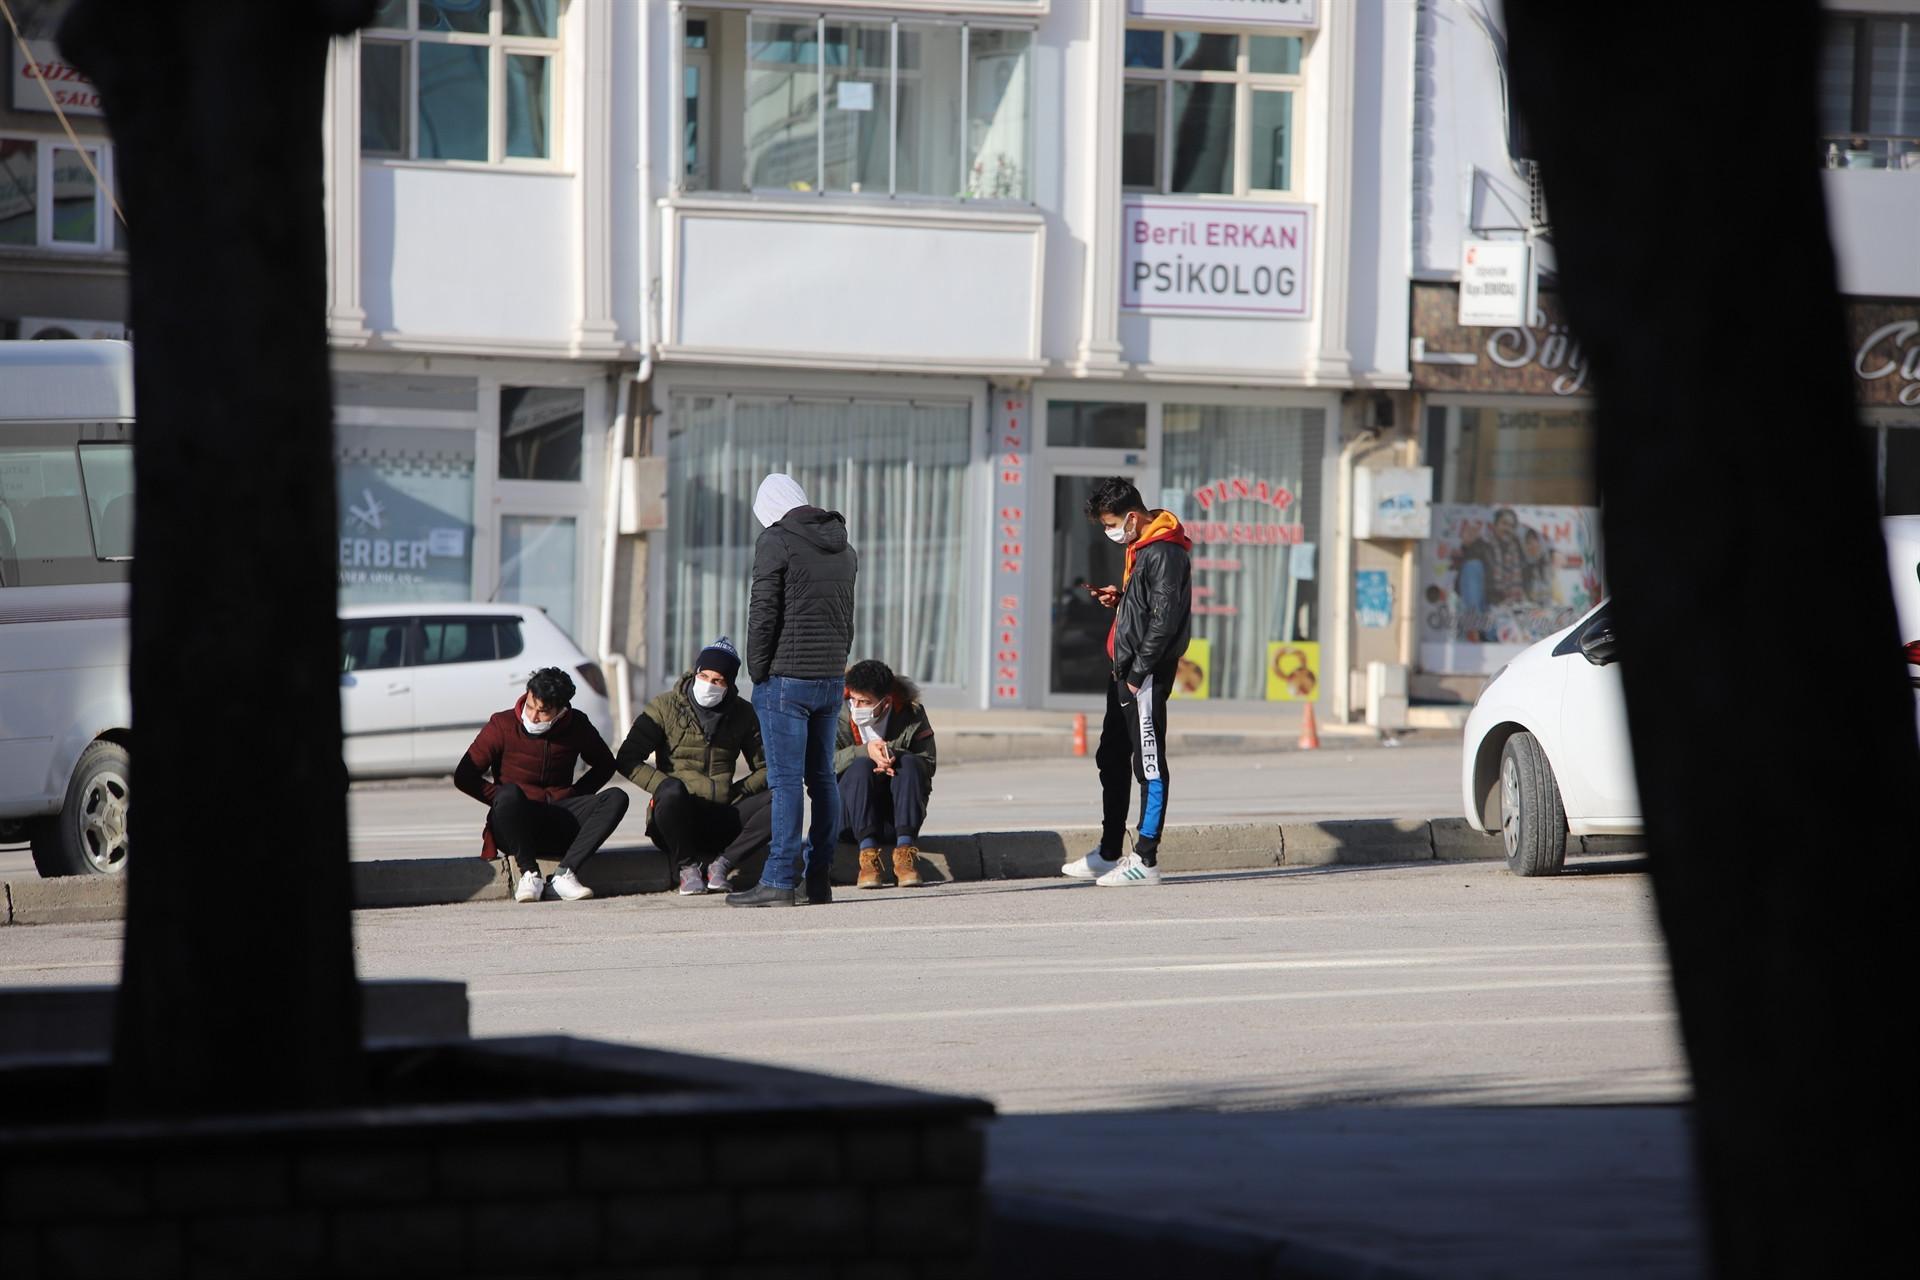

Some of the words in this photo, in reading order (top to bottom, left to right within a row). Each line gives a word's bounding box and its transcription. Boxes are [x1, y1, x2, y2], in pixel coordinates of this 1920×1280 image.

[55, 90, 102, 108] SALO
[1134, 221, 1196, 245] Beril
[1206, 223, 1297, 248] ERKAN
[1132, 254, 1295, 296] PSİKOLOG
[1195, 477, 1294, 511] PINAR
[1232, 523, 1304, 545] SALONU
[340, 538, 427, 569] ERBER
[1143, 716, 1155, 747] NIKE
